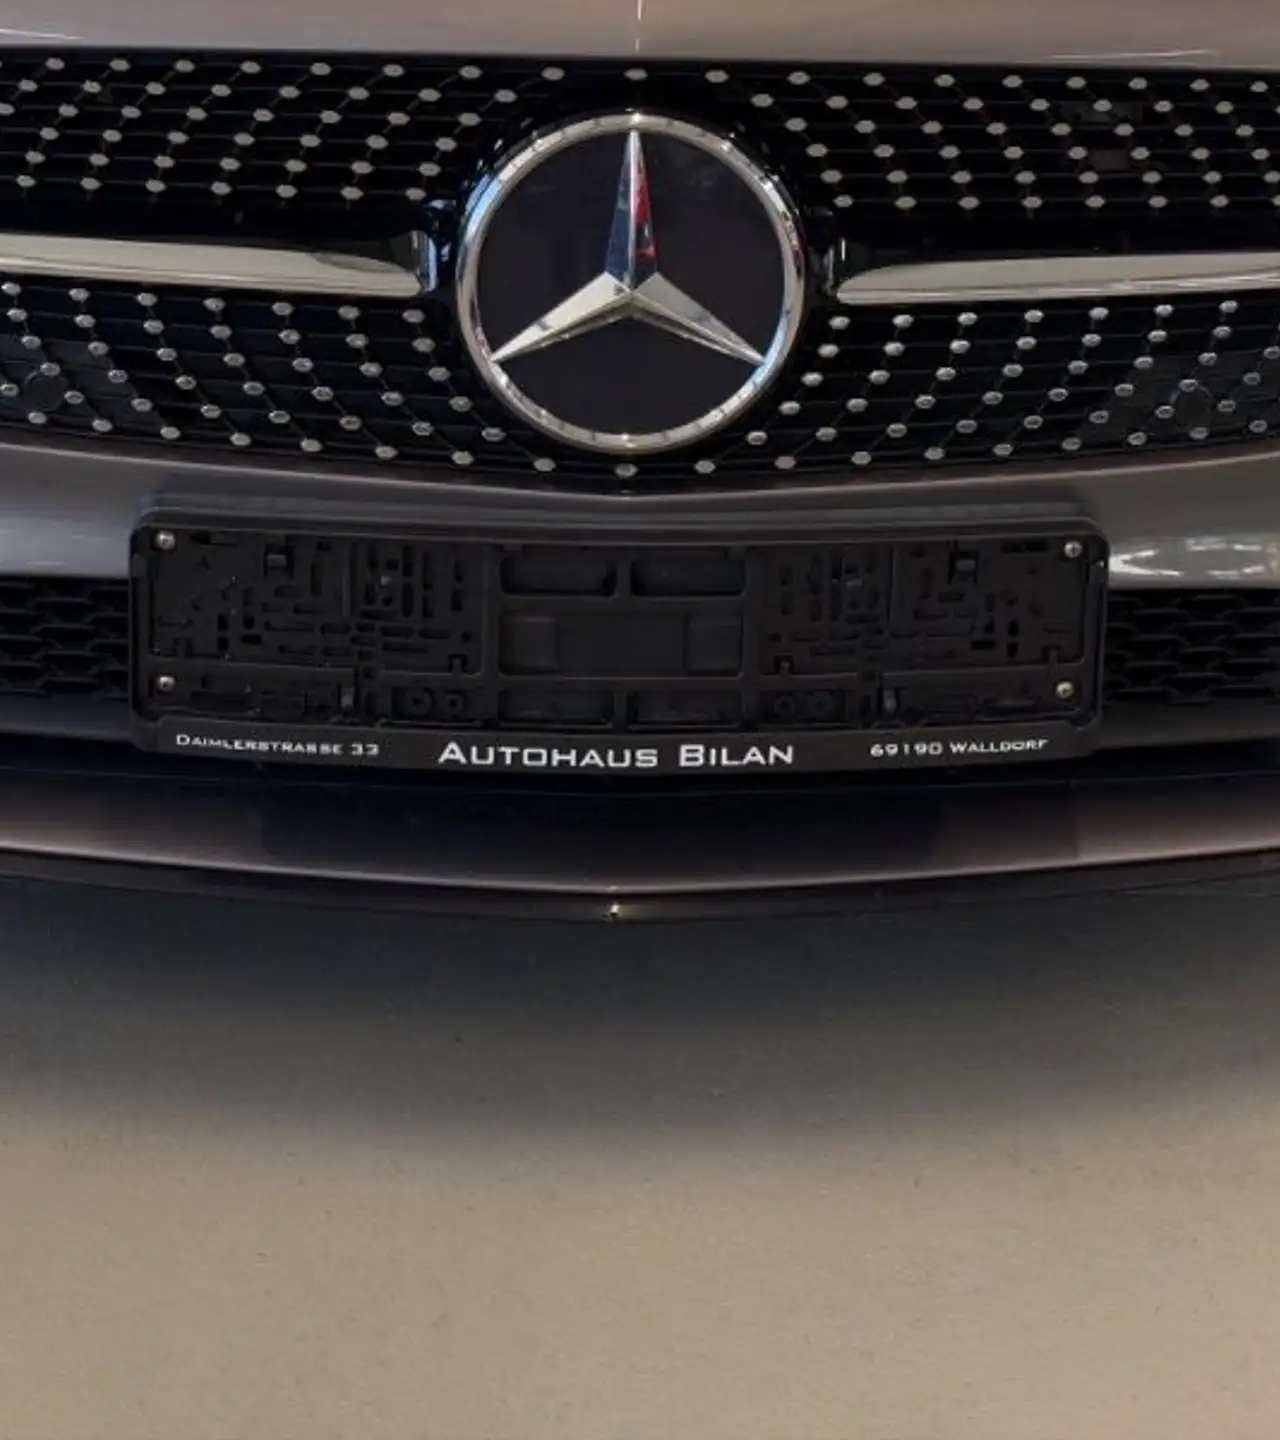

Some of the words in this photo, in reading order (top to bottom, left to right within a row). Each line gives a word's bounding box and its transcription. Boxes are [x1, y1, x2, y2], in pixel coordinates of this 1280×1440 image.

[351, 742, 380, 756] 33
[437, 741, 659, 768] AUTOHAUS
[678, 744, 794, 767] BILAN
[870, 742, 944, 758] 69190
[949, 739, 1049, 754] WALLDORF
